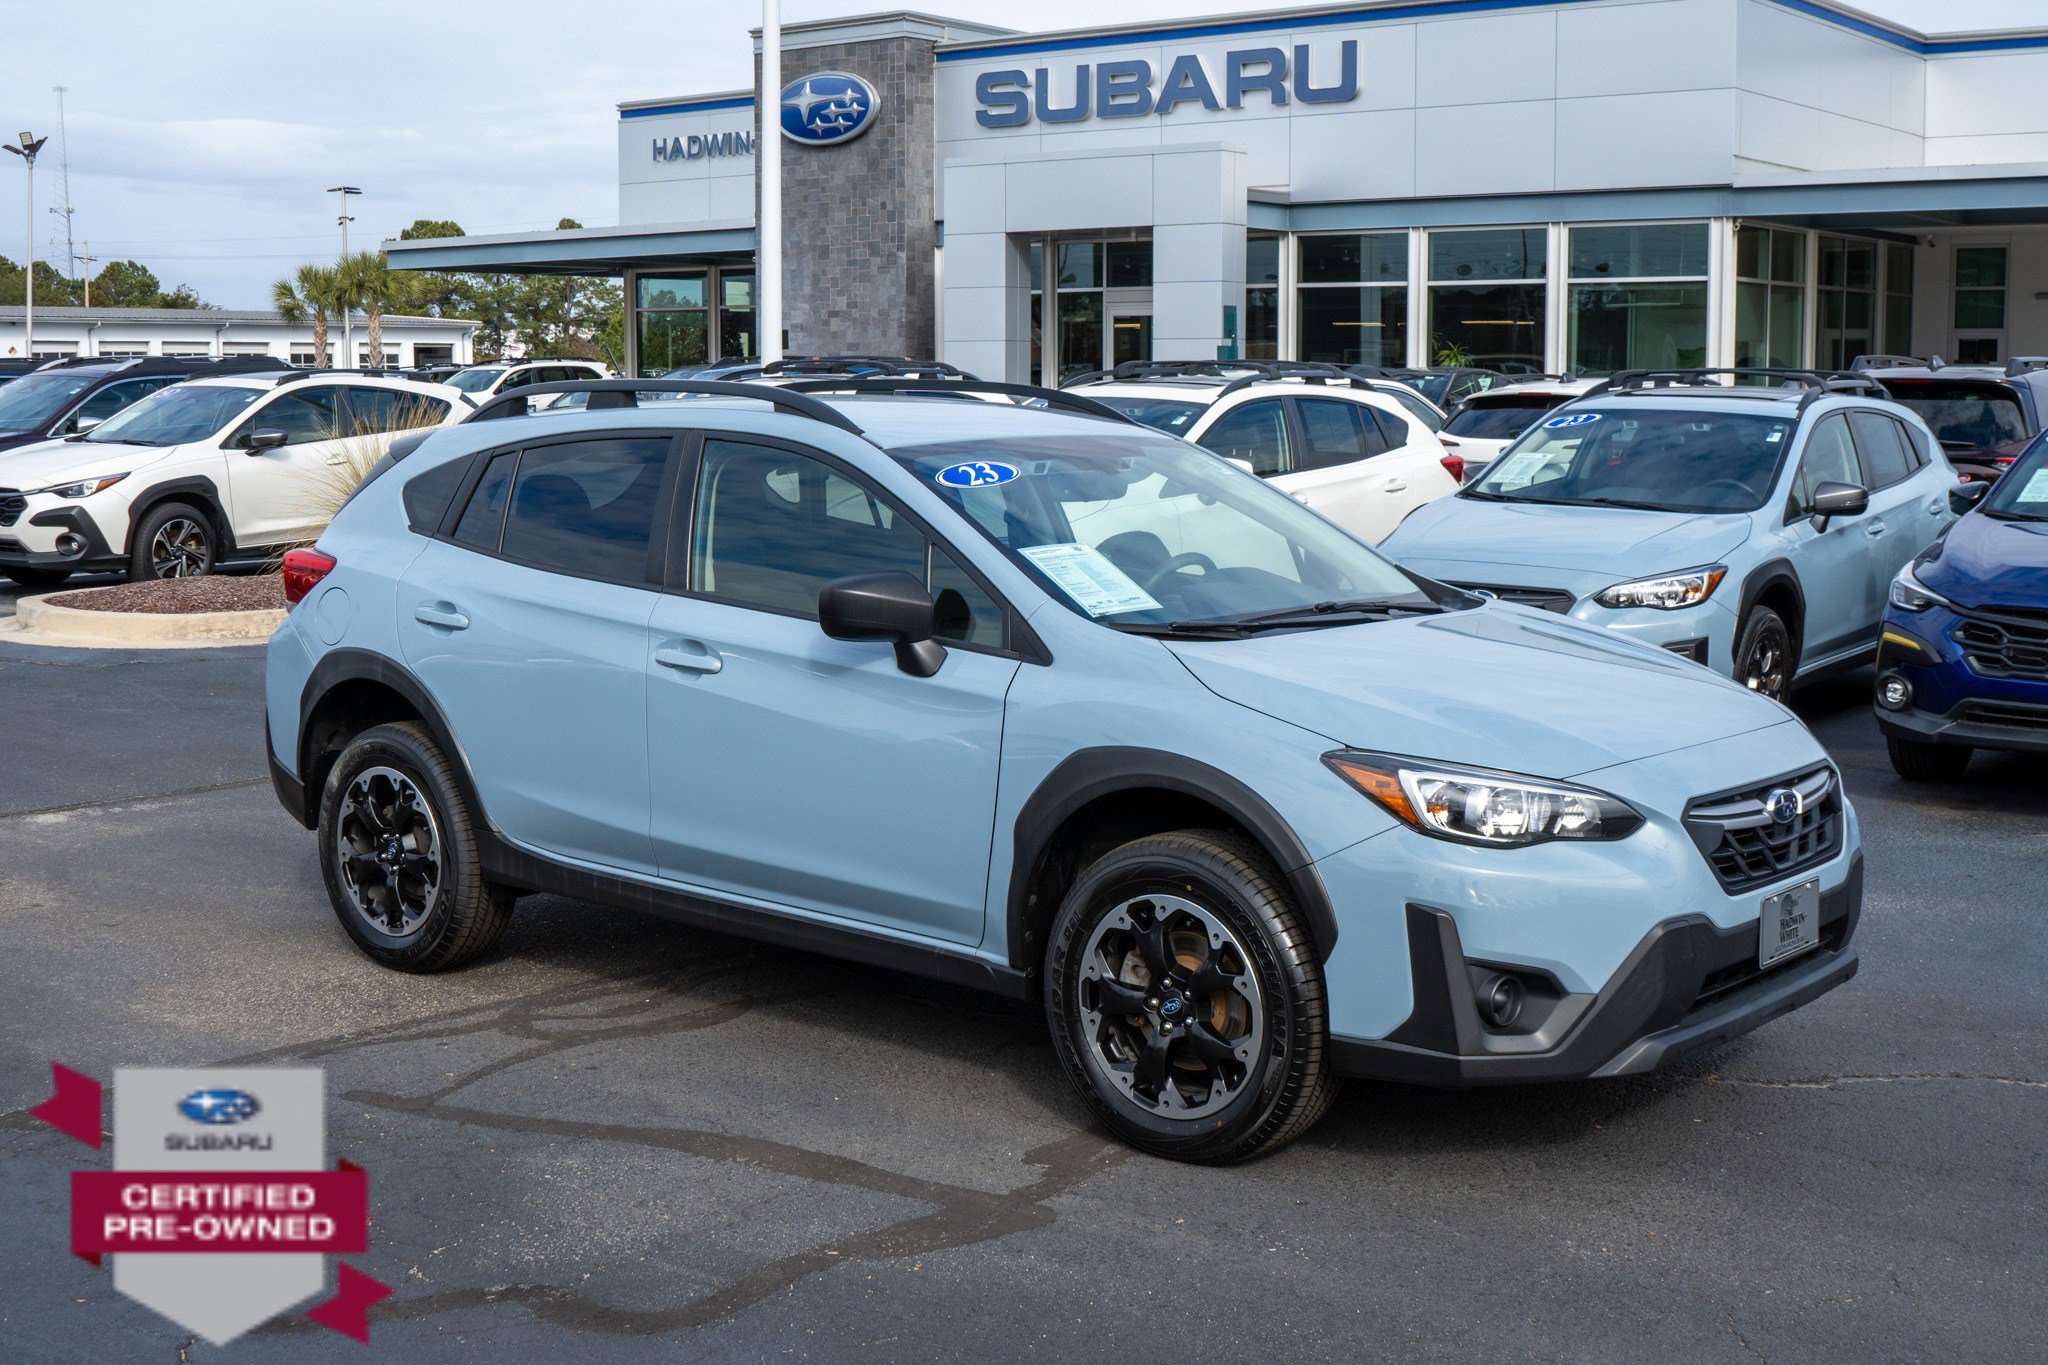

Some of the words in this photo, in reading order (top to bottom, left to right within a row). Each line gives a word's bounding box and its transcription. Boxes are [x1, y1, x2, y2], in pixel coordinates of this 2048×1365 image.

[975, 39, 1361, 128] SUBARU
[958, 462, 999, 486] 23
[1227, 899, 1287, 1059] YOKOHAMA
